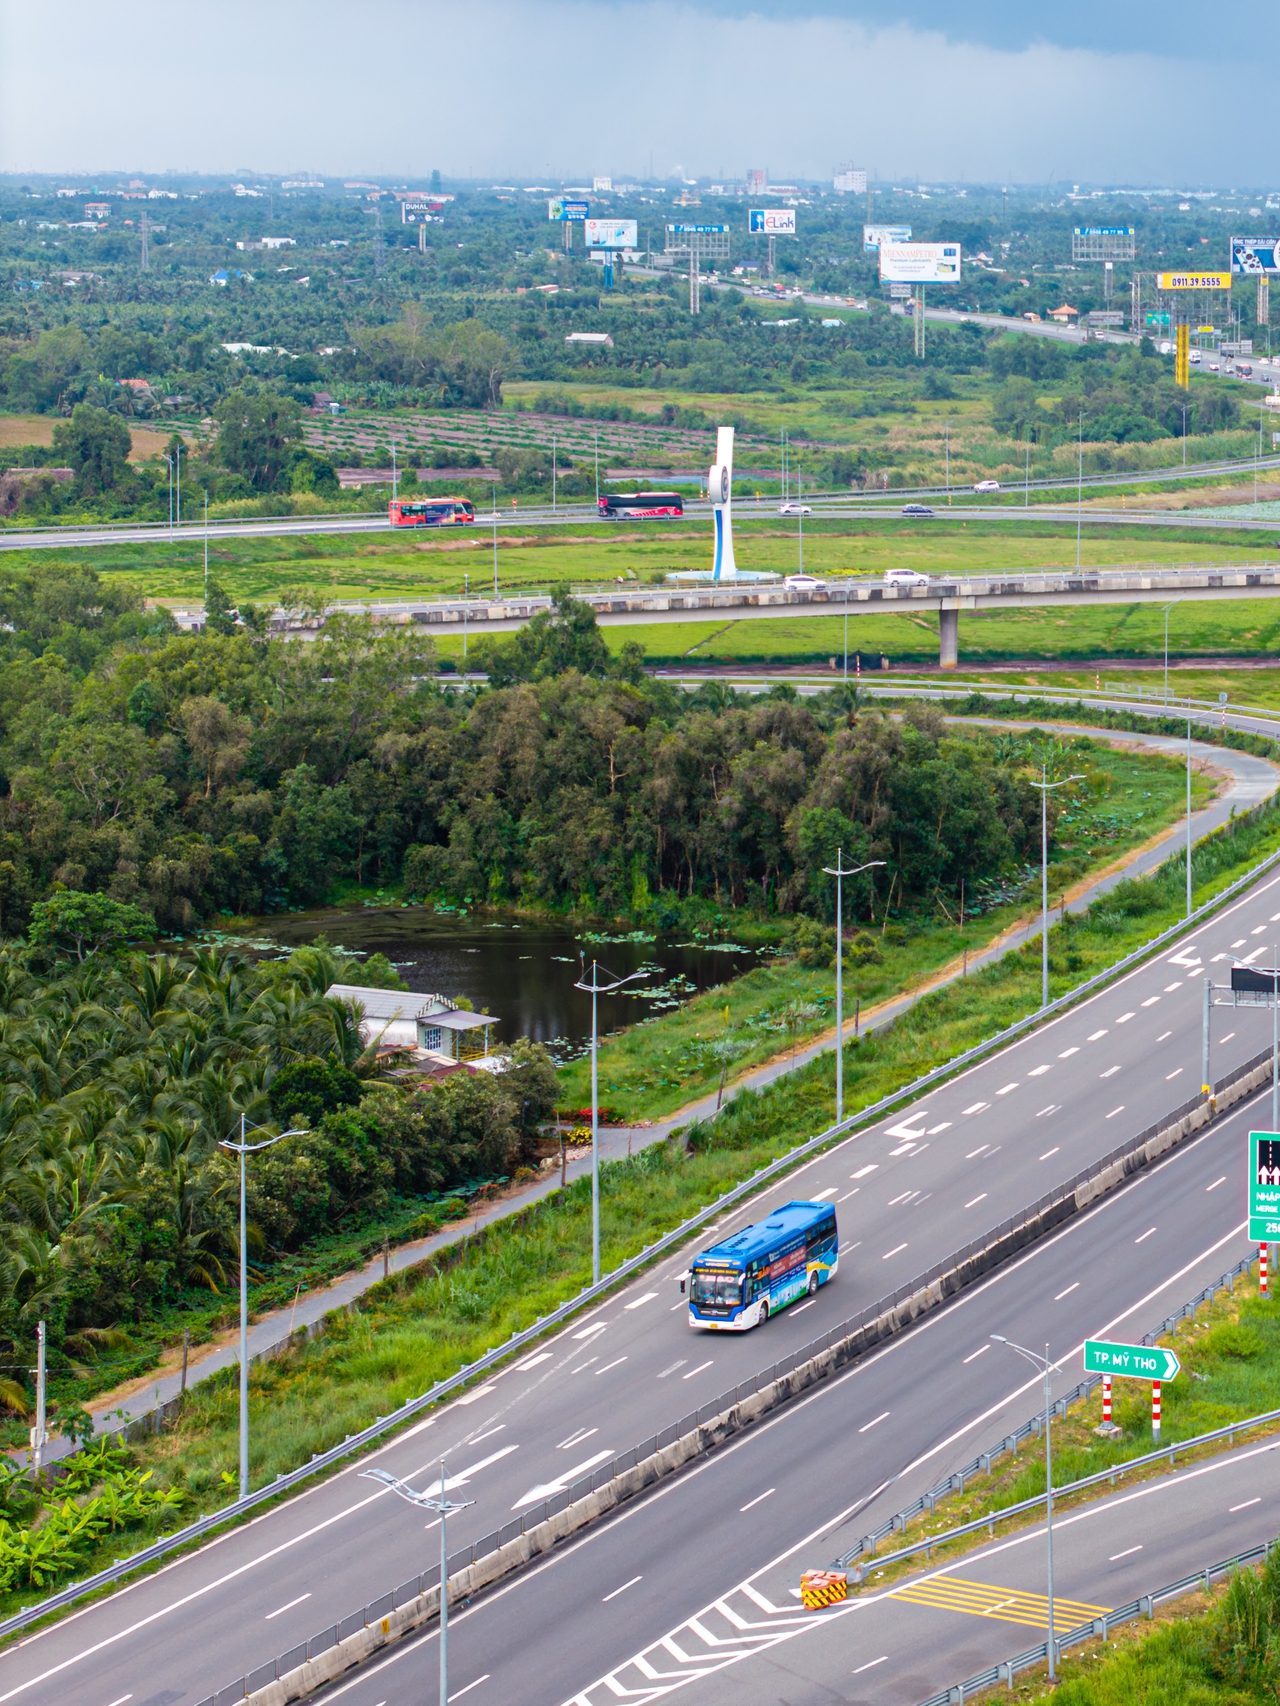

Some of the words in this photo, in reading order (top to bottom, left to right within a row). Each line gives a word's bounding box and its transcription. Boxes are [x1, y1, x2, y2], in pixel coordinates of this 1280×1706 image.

[1172, 277, 1221, 287] 0911.39.5555
[1256, 1190, 1280, 1203] NHẬP
[1256, 1204, 1278, 1213] MERGE
[1133, 1355, 1157, 1370] THO
